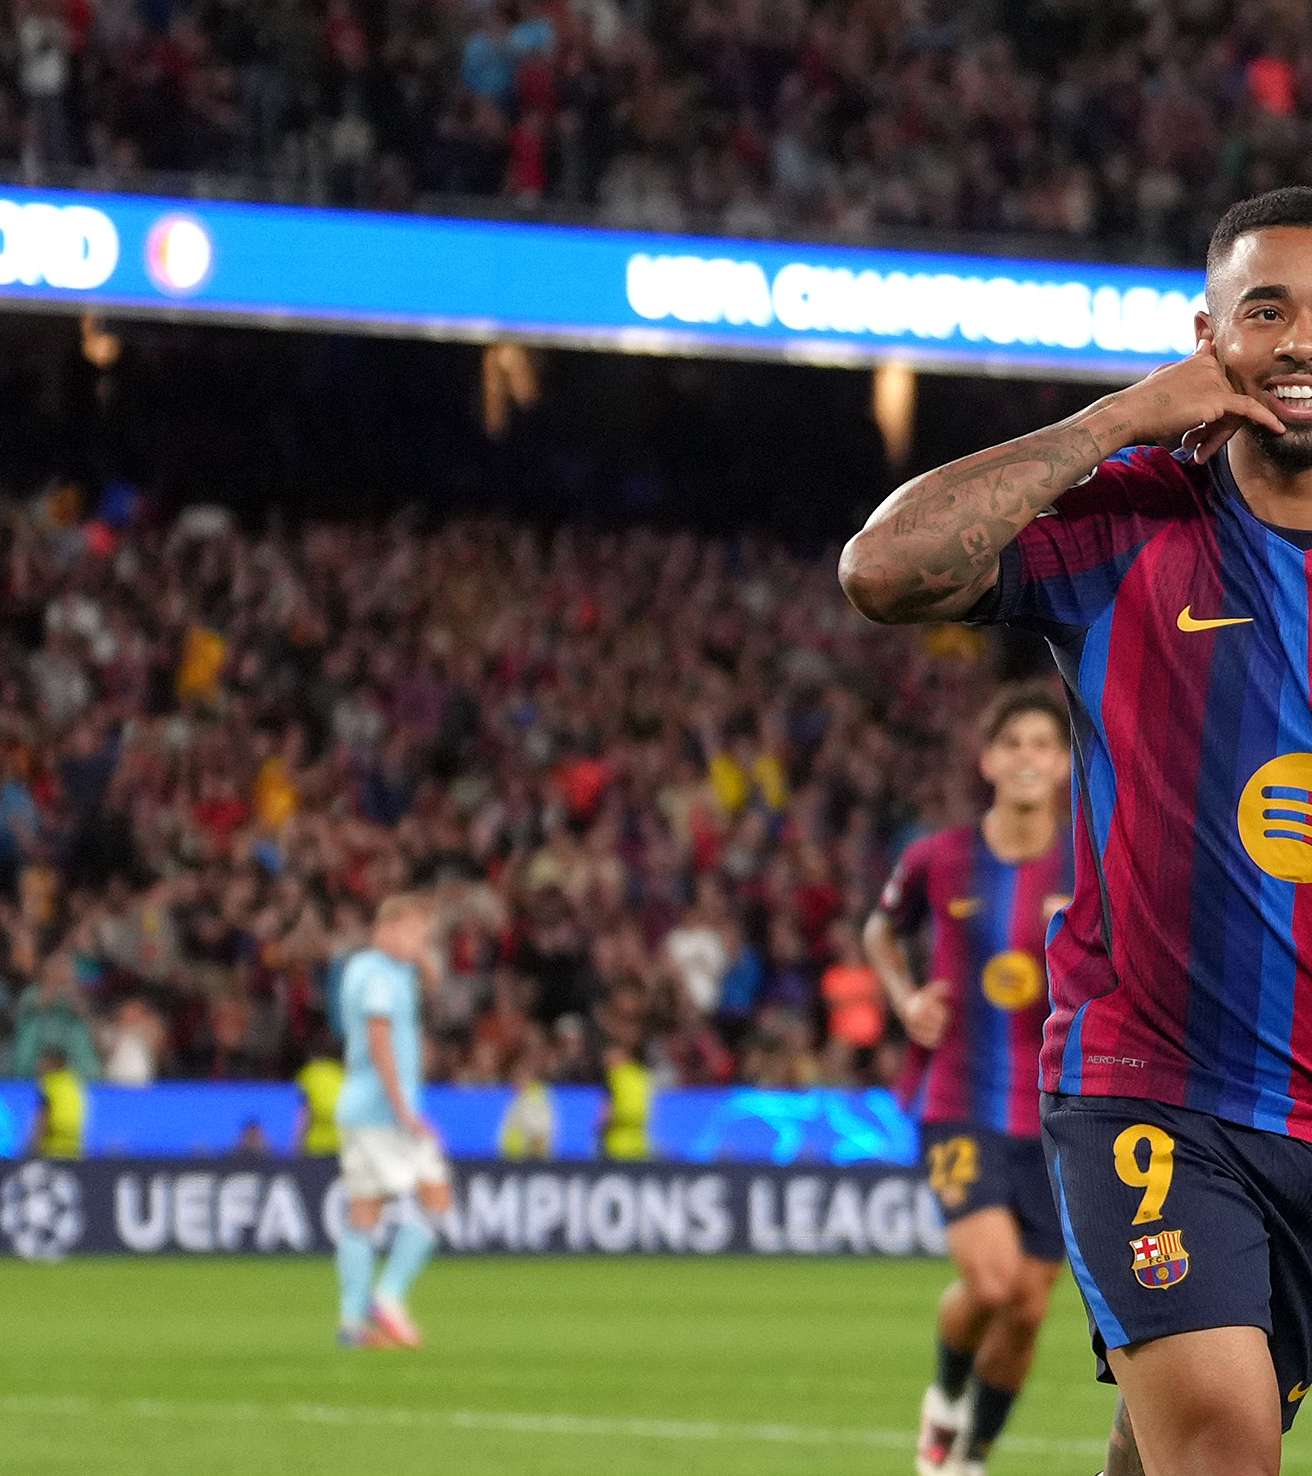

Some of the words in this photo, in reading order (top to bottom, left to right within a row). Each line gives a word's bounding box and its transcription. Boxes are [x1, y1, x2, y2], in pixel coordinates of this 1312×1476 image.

[1092, 284, 1206, 355] LEA
[1087, 1055, 1149, 1069] AERO-FIT
[115, 1174, 309, 1251] UEFA
[323, 1172, 733, 1253] CAMPIONS
[1113, 1124, 1174, 1225] 9
